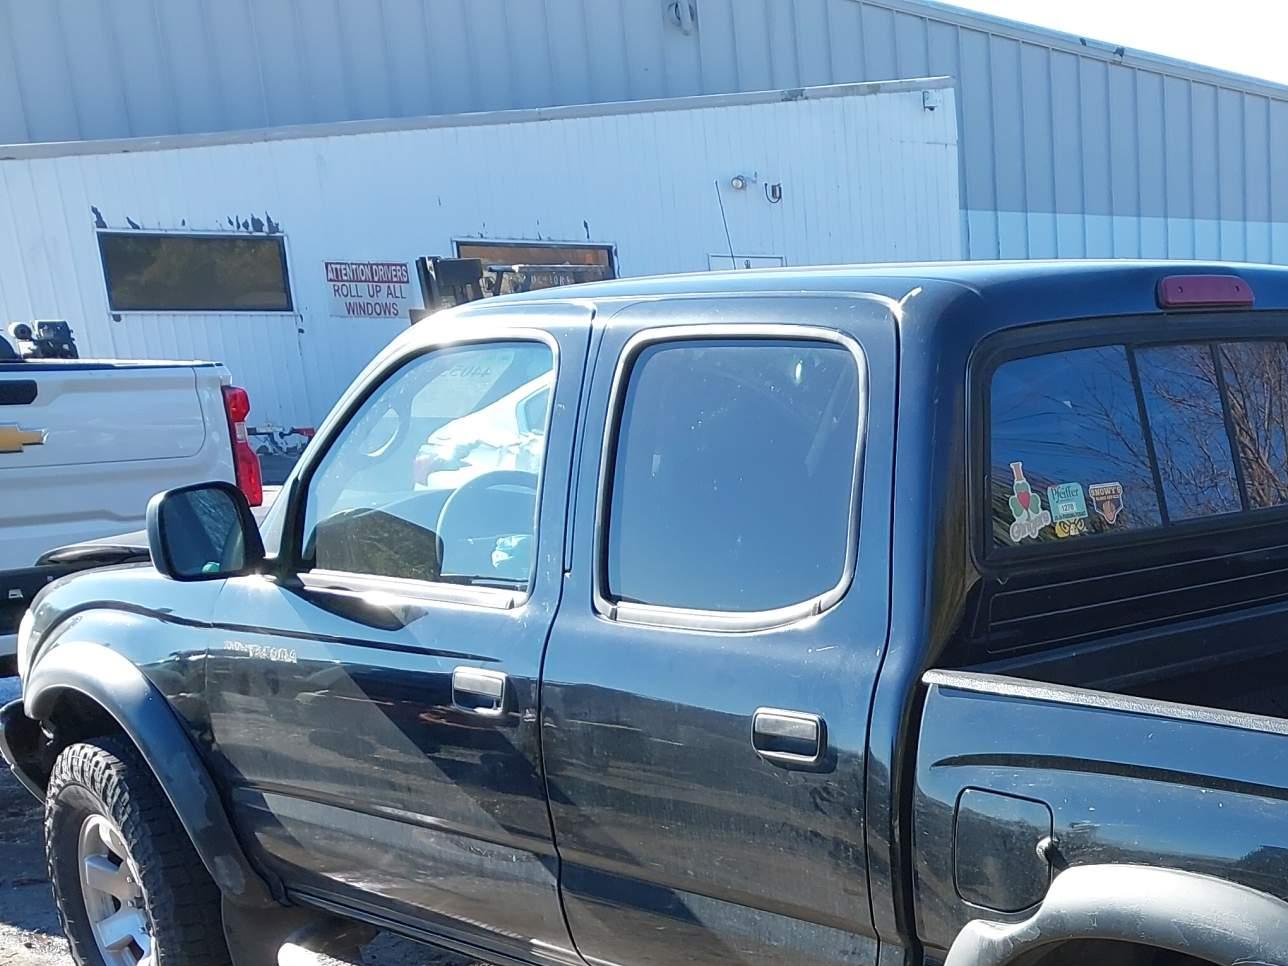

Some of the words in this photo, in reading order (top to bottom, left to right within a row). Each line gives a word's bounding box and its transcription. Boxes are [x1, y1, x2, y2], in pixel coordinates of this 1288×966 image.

[327, 263, 371, 281] ATTENTION
[372, 264, 408, 282] DRIVERS
[333, 284, 362, 298] ROLL
[367, 284, 381, 298] UP
[386, 285, 406, 299] ALL
[345, 302, 399, 316] WINDOWS
